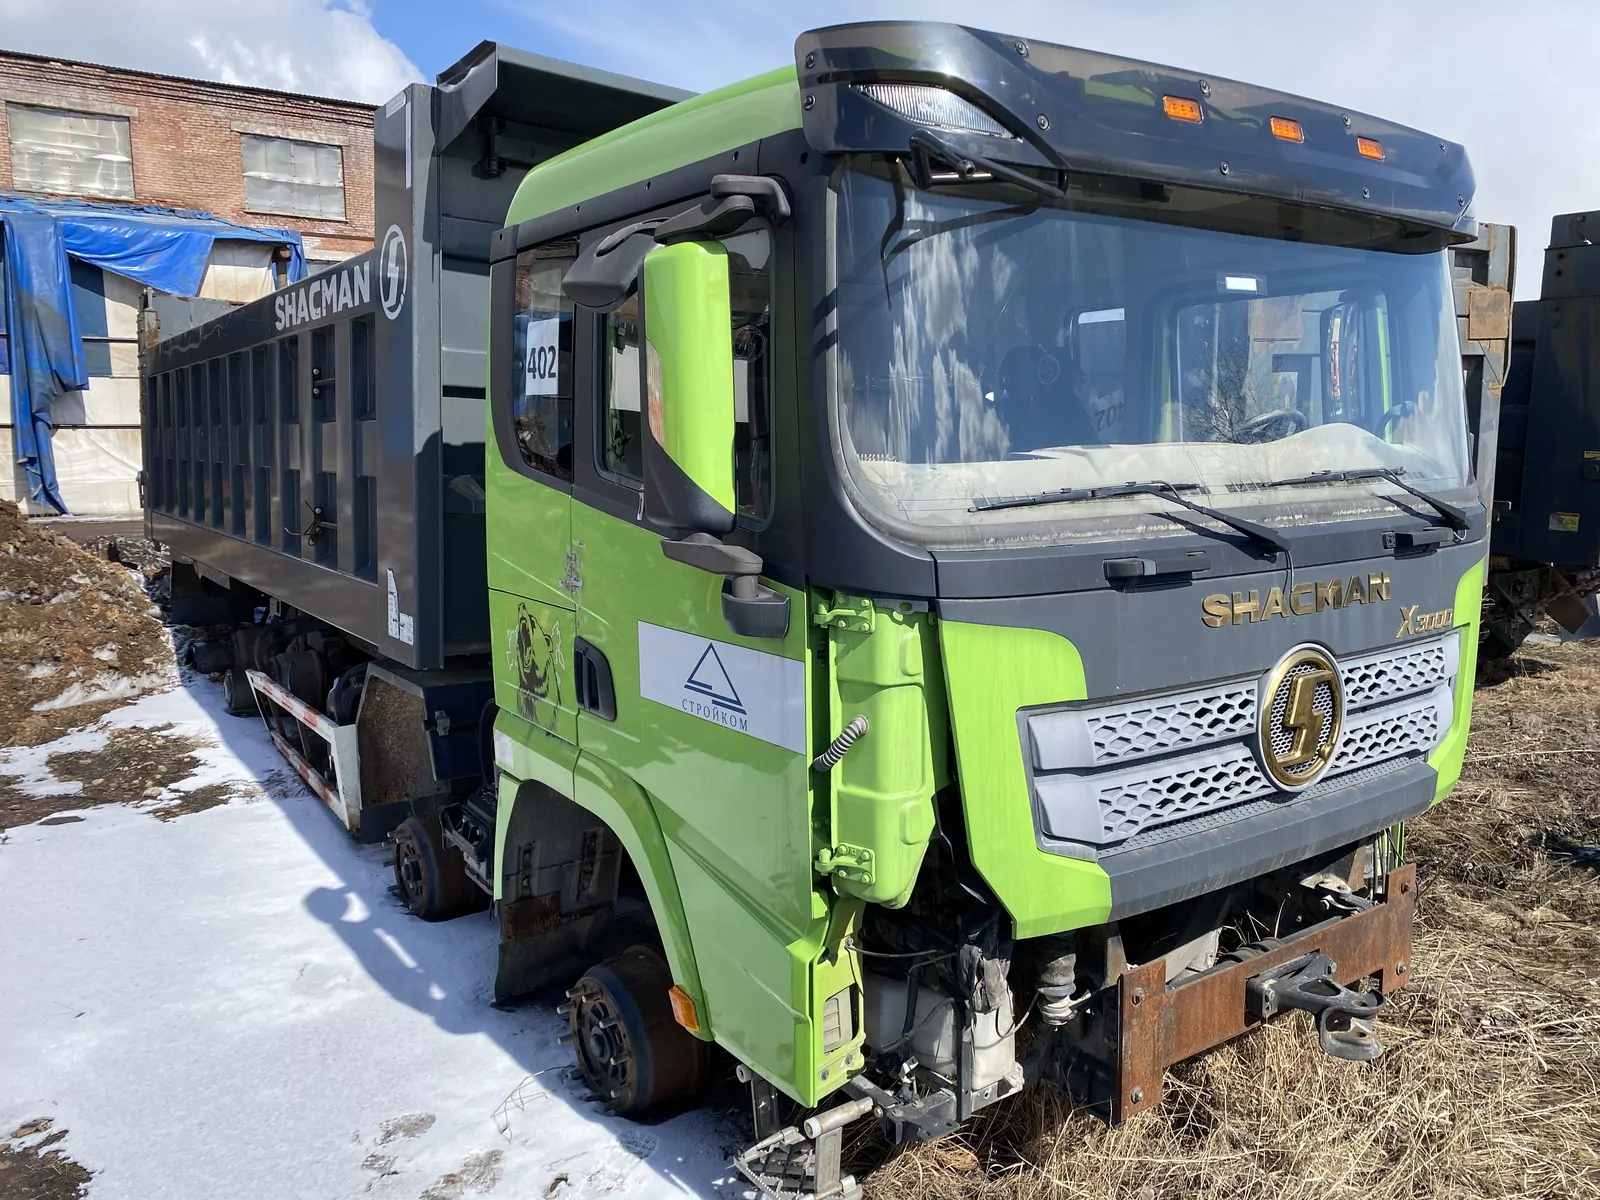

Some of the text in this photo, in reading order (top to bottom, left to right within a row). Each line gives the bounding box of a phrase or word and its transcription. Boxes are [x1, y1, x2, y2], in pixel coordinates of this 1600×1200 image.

[275, 261, 370, 330] SHACMAN
[527, 345, 557, 379] 402
[1201, 572, 1391, 628] SHACMAN
[1395, 604, 1453, 639] X3000
[682, 698, 748, 731] СТРОЙКОМ
